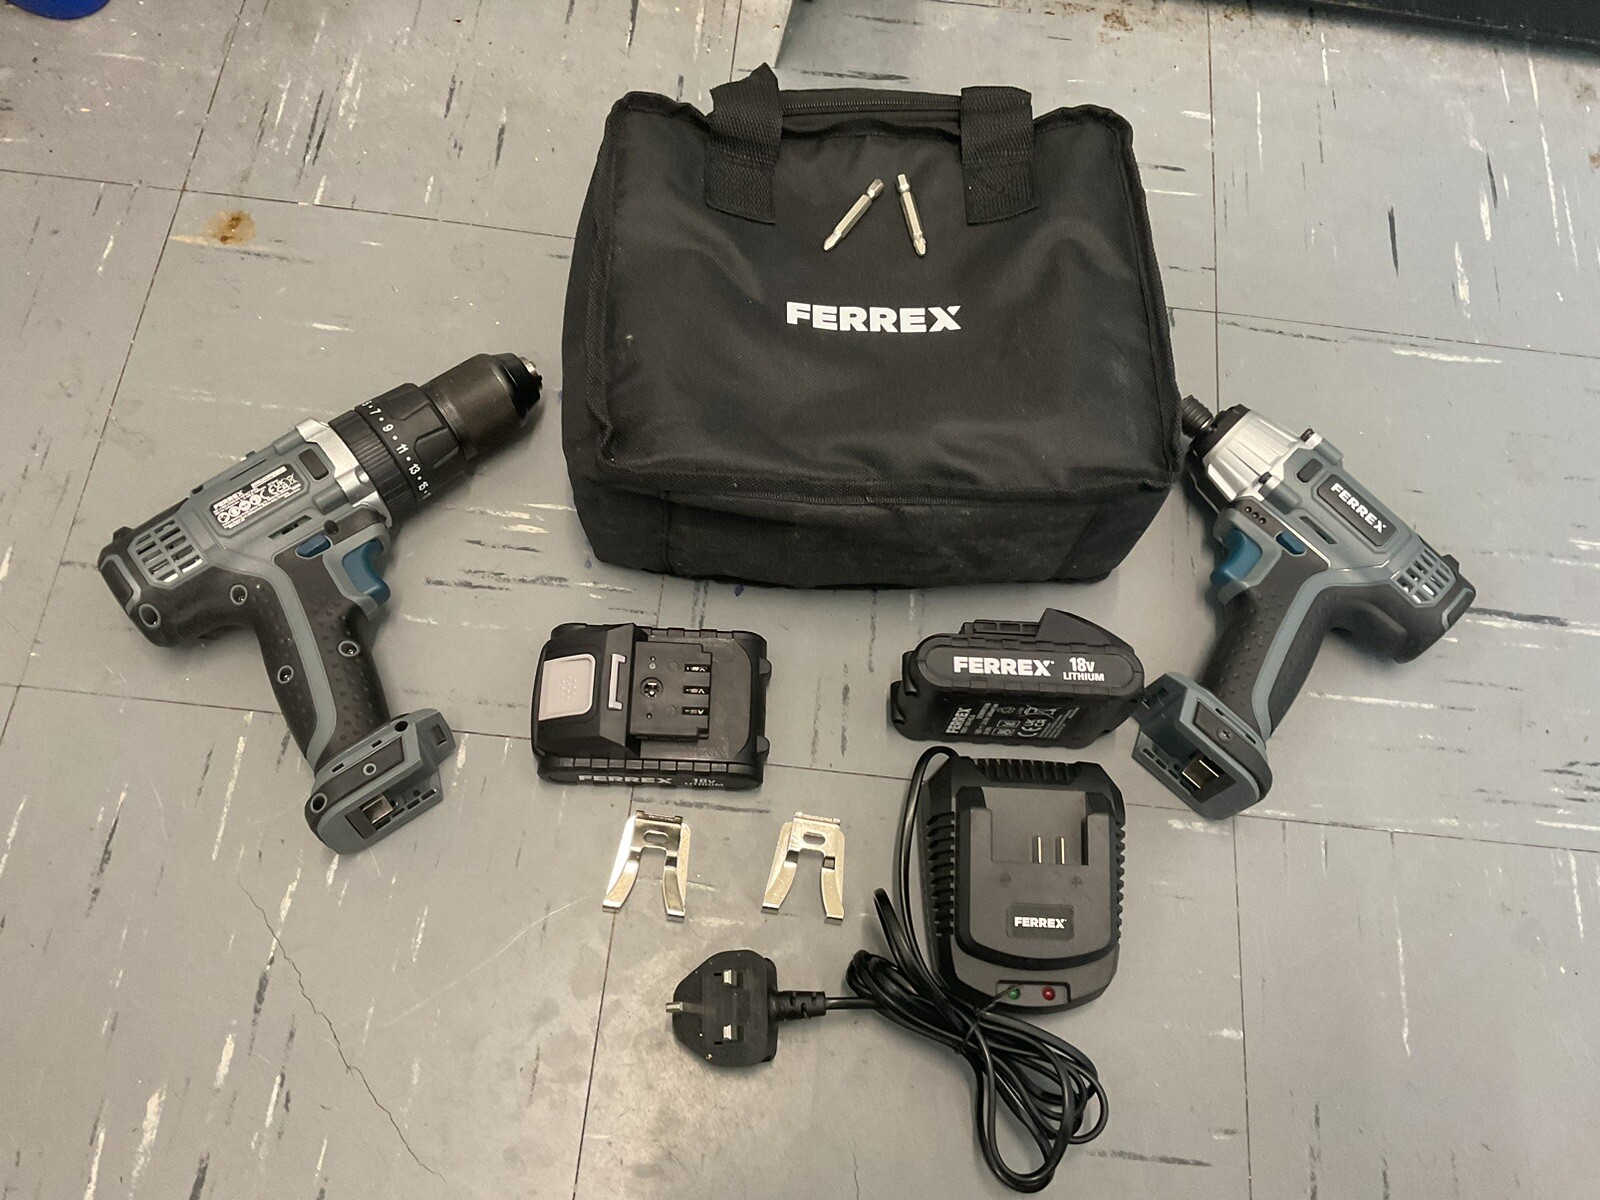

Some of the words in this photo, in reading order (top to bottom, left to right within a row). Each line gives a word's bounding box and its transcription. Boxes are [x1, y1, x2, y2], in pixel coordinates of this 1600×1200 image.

[786, 301, 962, 333] FERREX
[382, 423, 394, 432] 9
[396, 443, 409, 454] 11
[409, 463, 421, 475] 13
[1330, 482, 1384, 534] FERREX
[953, 656, 1052, 677] FERREX
[1062, 671, 1105, 682] LITHIUM
[578, 774, 673, 785] FERREX
[1014, 916, 1066, 929] FERREX
